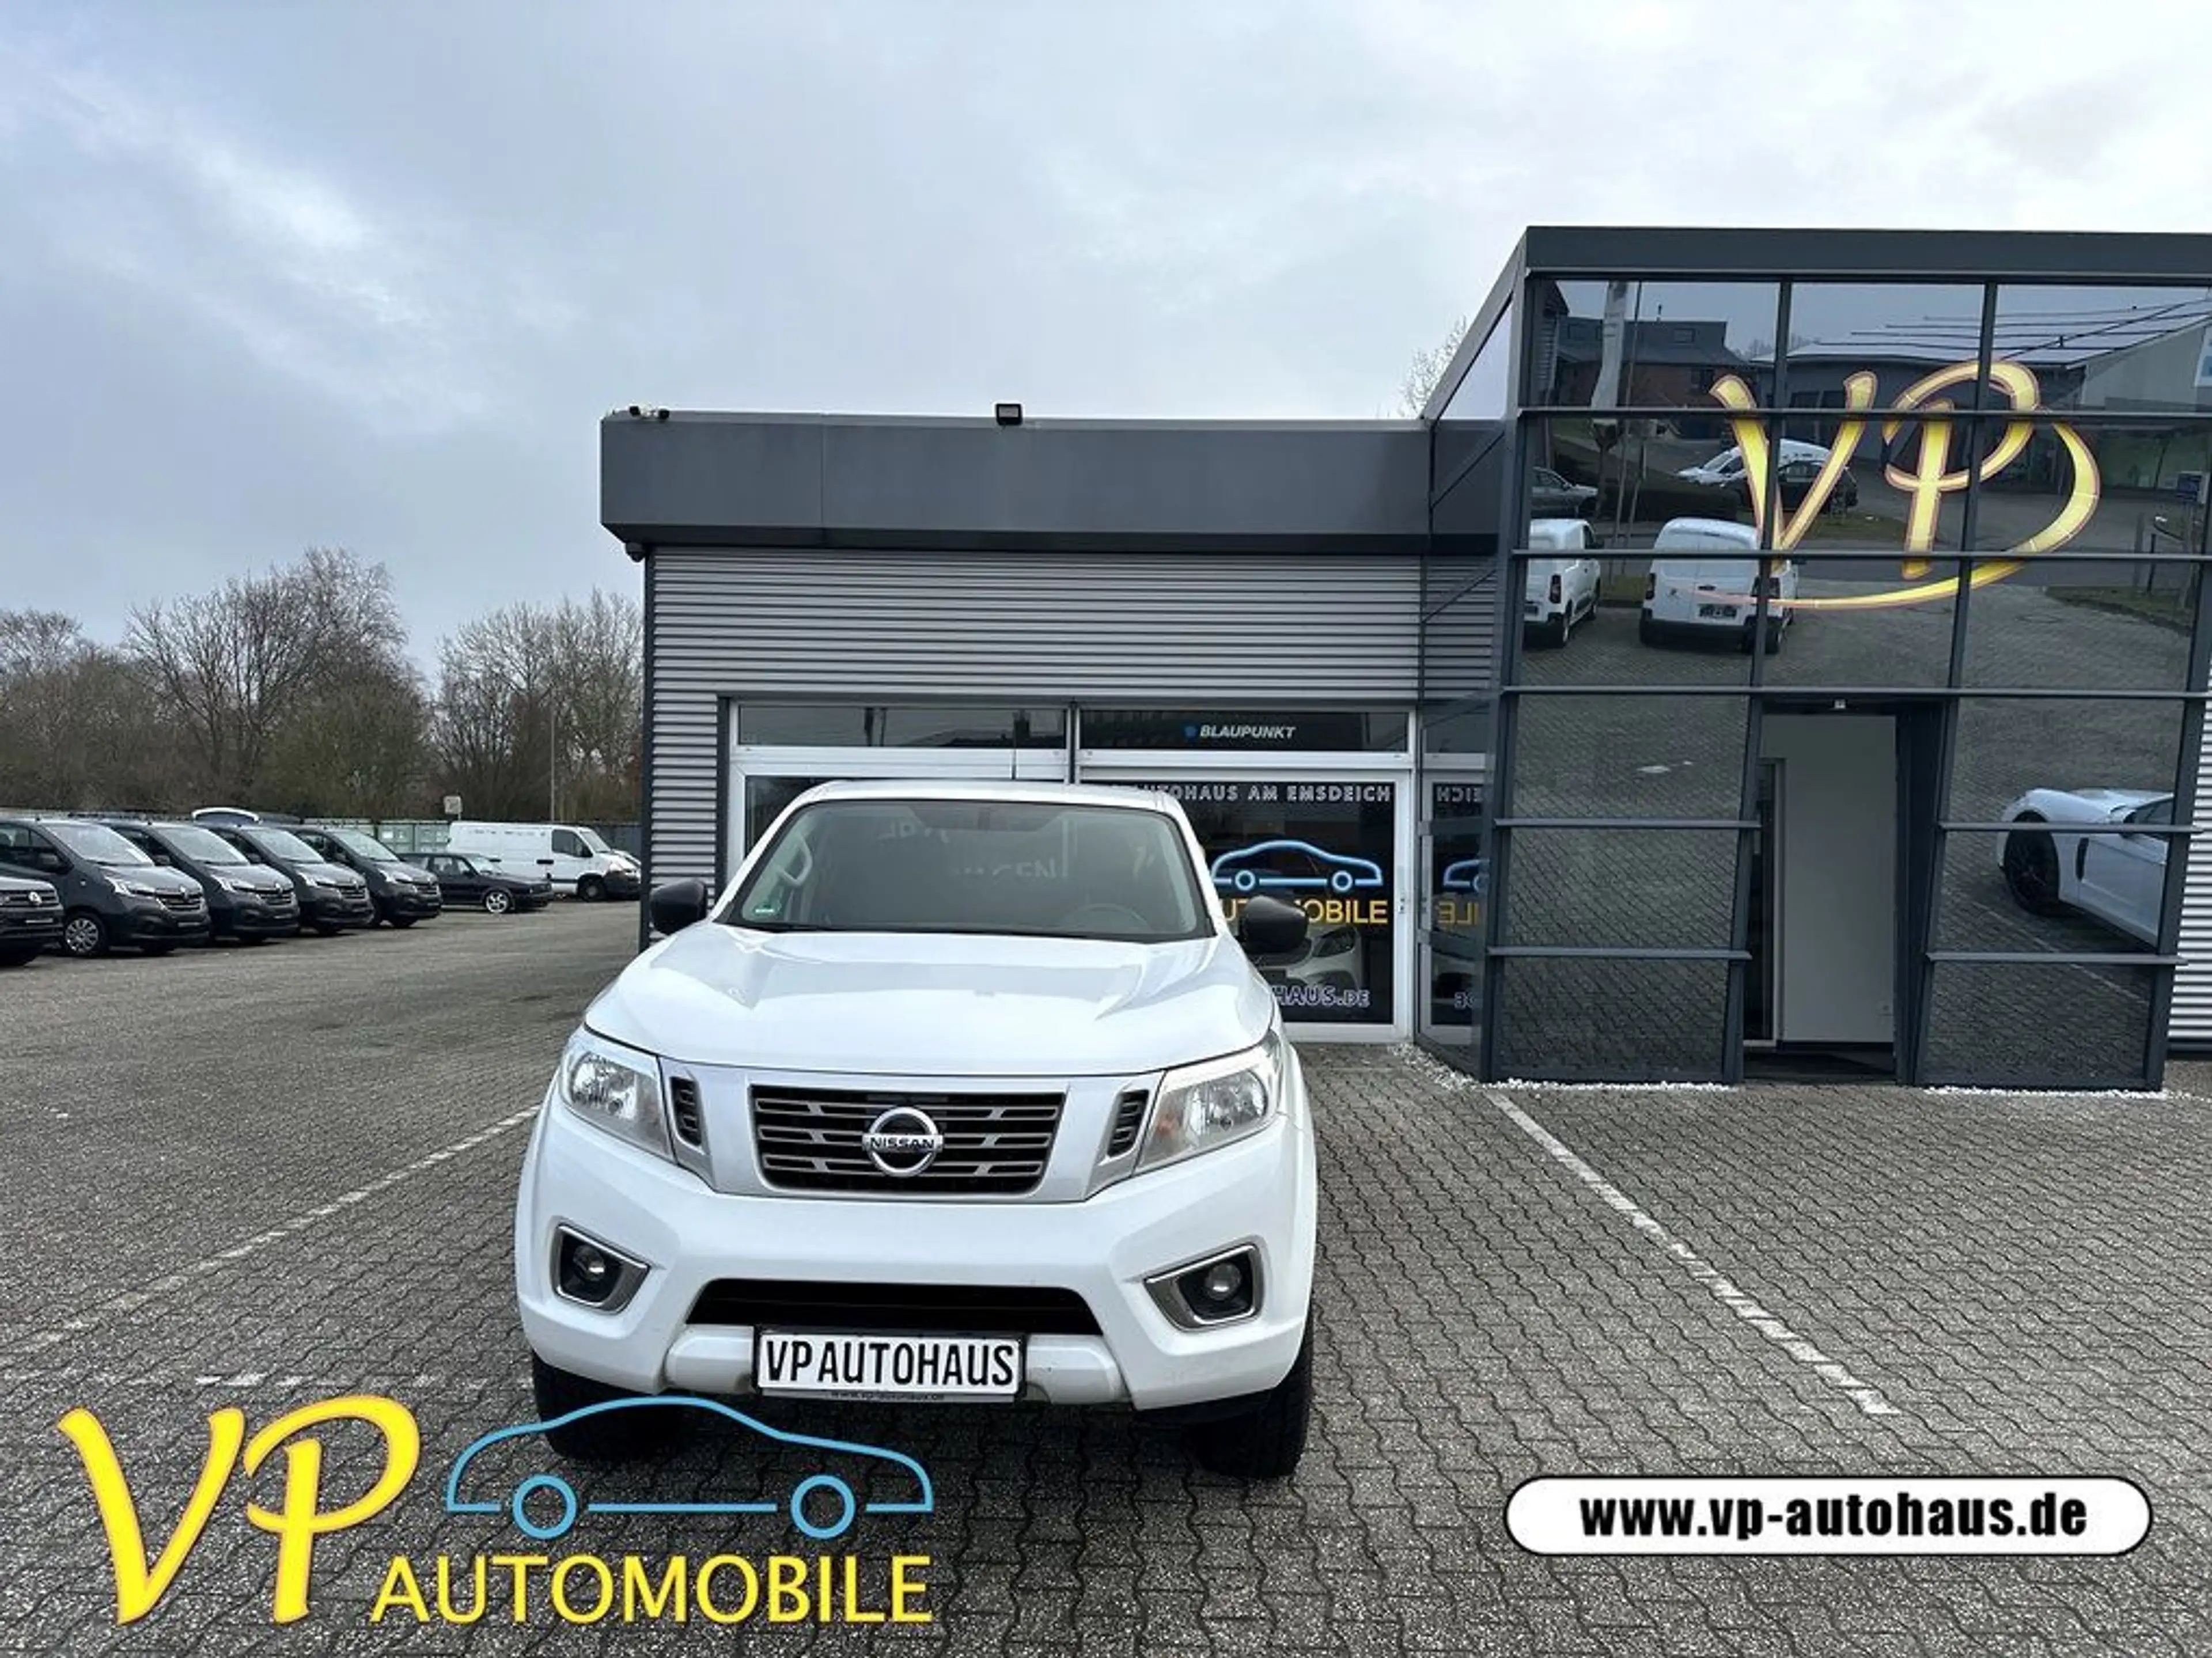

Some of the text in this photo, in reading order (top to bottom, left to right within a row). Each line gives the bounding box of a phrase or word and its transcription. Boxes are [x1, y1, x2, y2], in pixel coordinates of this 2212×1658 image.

[1710, 361, 2101, 610] VP
[1199, 724, 1297, 739] BLAUPUNKT
[1248, 786, 1278, 801] AM
[1287, 786, 1391, 802] EMSDEICH
[869, 1137, 935, 1149] NISSAN
[767, 1340, 1013, 1386] VP AUTOHAUS
